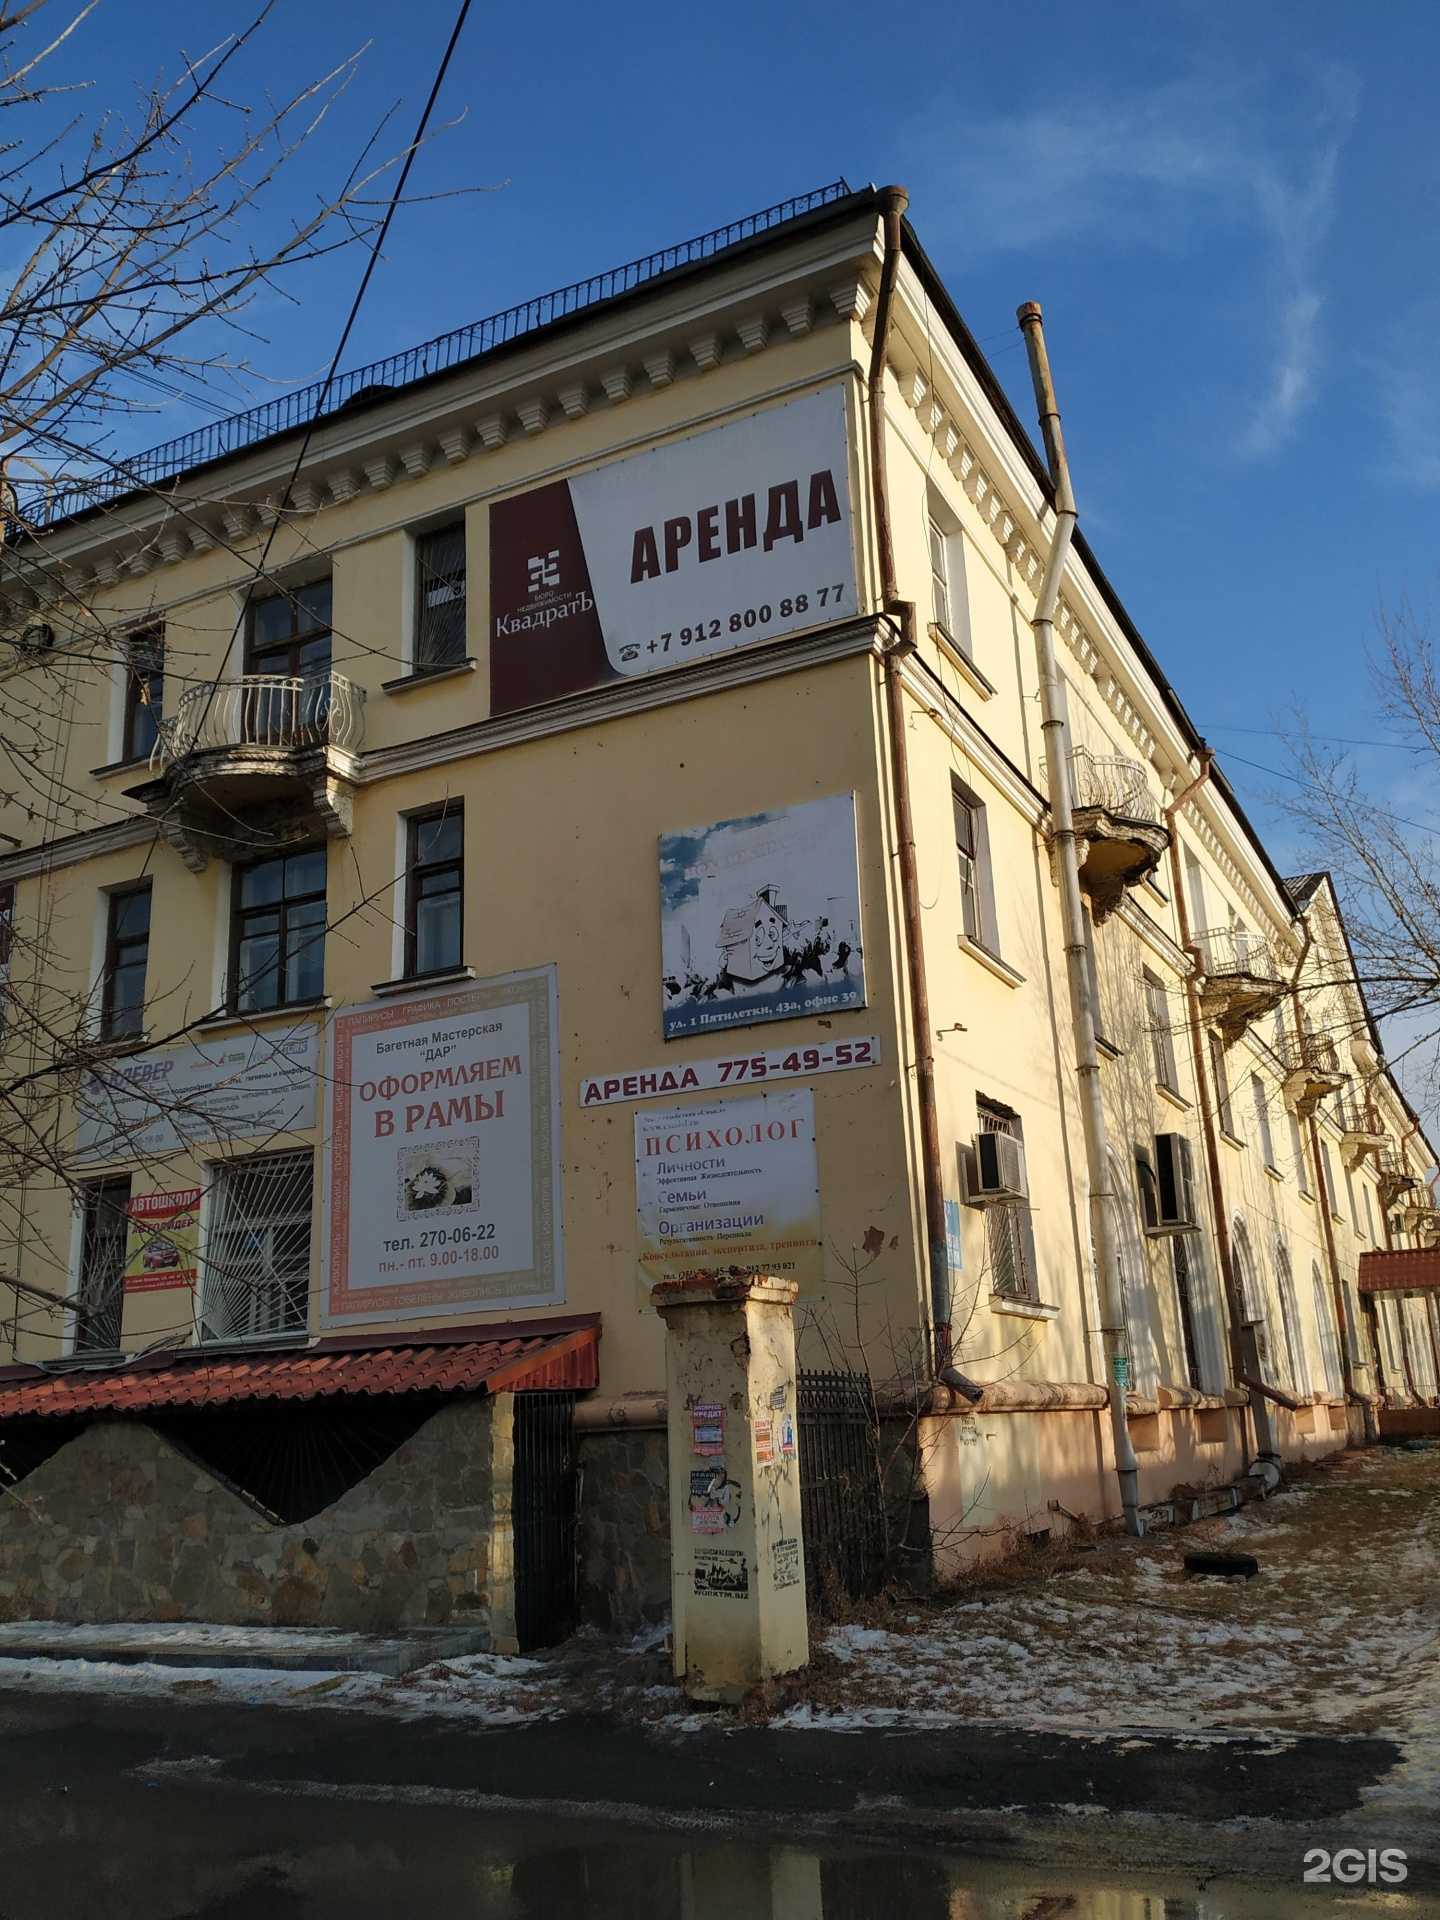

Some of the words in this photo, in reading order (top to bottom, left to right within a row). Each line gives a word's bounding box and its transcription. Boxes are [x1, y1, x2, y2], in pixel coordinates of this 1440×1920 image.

[630, 468, 842, 585] АРЕНДА
[646, 632, 672, 654] +7
[679, 619, 721, 646] 912
[729, 604, 772, 633] 800
[779, 594, 809, 617] 88
[816, 583, 845, 607] 77
[669, 1019, 687, 1032] ул.
[690, 1017, 697, 1027] 1
[804, 995, 839, 1009] офис
[376, 1035, 428, 1054] Багетная
[432, 1021, 503, 1045] Мастерская
[359, 1055, 522, 1102] ОФОРМЛЯЕМ
[584, 1067, 700, 1105] АРЕНДА
[717, 1042, 872, 1083] 775-49-52
[374, 1109, 394, 1138] В
[405, 1090, 505, 1133] РАМЫ
[645, 1118, 805, 1157] ПСИХОЛОГ
[657, 1158, 726, 1175] Личности
[131, 1191, 199, 1212] АВТОШКОЛА
[658, 1190, 707, 1204] Семьи
[383, 1237, 415, 1253] тел.
[420, 1223, 496, 1248] 270-06-22
[658, 1214, 765, 1237] Организации
[430, 1245, 499, 1266] 9.00-18.00
